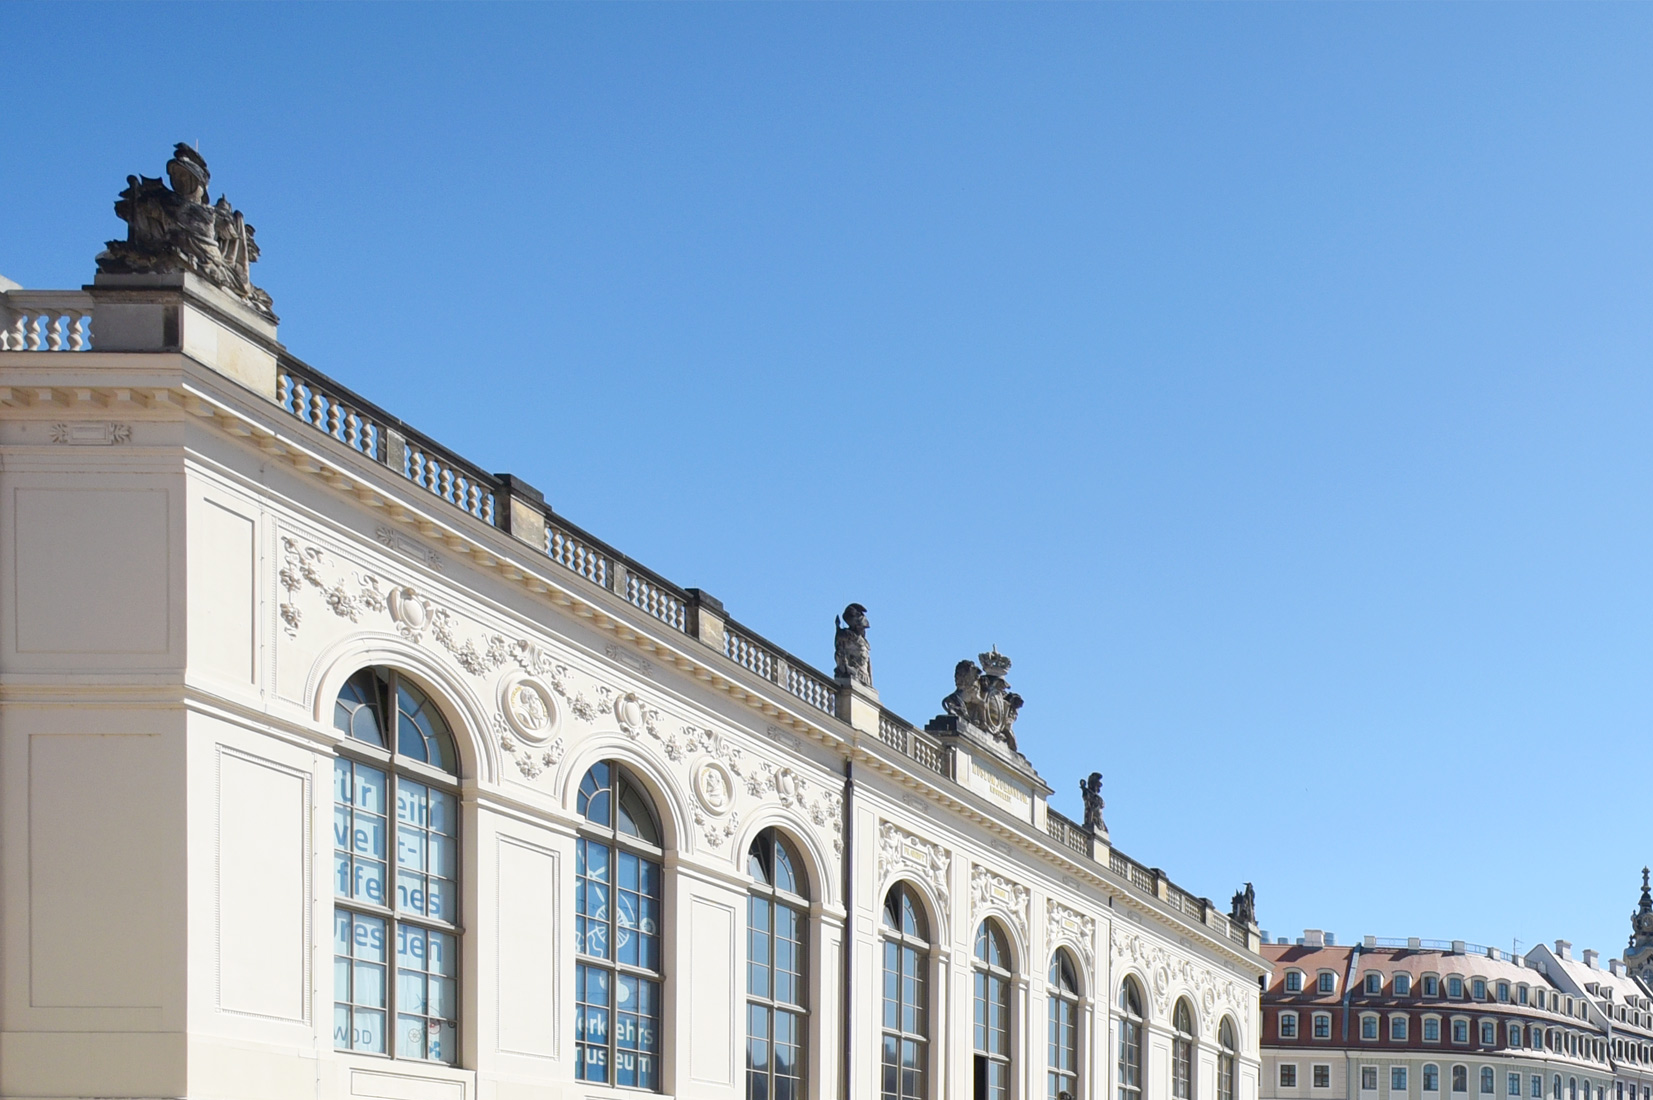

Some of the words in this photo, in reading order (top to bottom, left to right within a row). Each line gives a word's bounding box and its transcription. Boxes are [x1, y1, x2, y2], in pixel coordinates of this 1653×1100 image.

[334, 767, 371, 807] ür
[398, 792, 433, 828] ein
[335, 861, 440, 914] ffenes
[334, 917, 441, 962] resden
[576, 1009, 653, 1044] erkehrs
